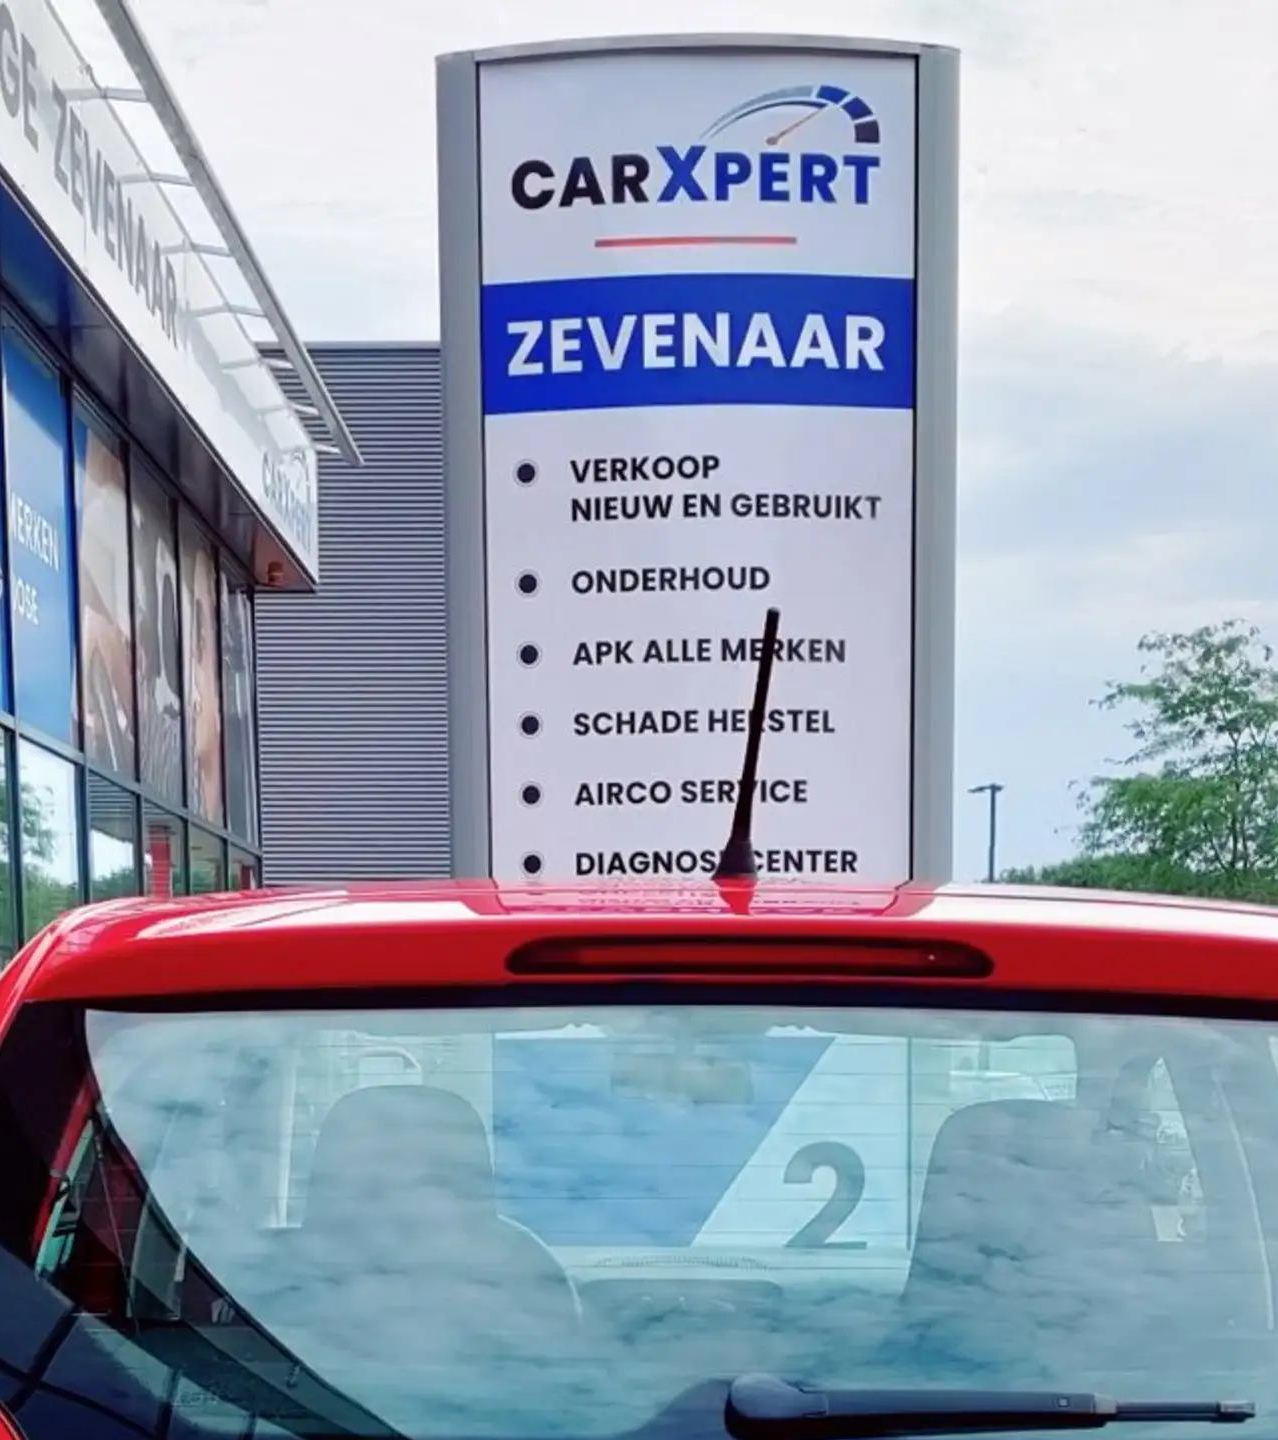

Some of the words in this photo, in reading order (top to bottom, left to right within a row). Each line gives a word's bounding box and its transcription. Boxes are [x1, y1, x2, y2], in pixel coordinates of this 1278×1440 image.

[510, 145, 880, 210] CARXPERT
[52, 77, 178, 351] ZEVENAAR
[507, 312, 886, 377] ZEVENAAR
[570, 455, 720, 483] VERKOOP
[571, 495, 673, 521] NIEUW
[683, 494, 721, 518] EN
[731, 494, 882, 520] GEBRUIKT
[572, 566, 770, 594] ONDERHOUD
[573, 641, 634, 665] APK
[643, 639, 712, 663] ALLE
[574, 710, 699, 735] SCHADE
[708, 709, 836, 733] HESTEL
[575, 781, 671, 806] AIRCO
[576, 850, 727, 875] DIAGNOS
[783, 1141, 867, 1250] 2
